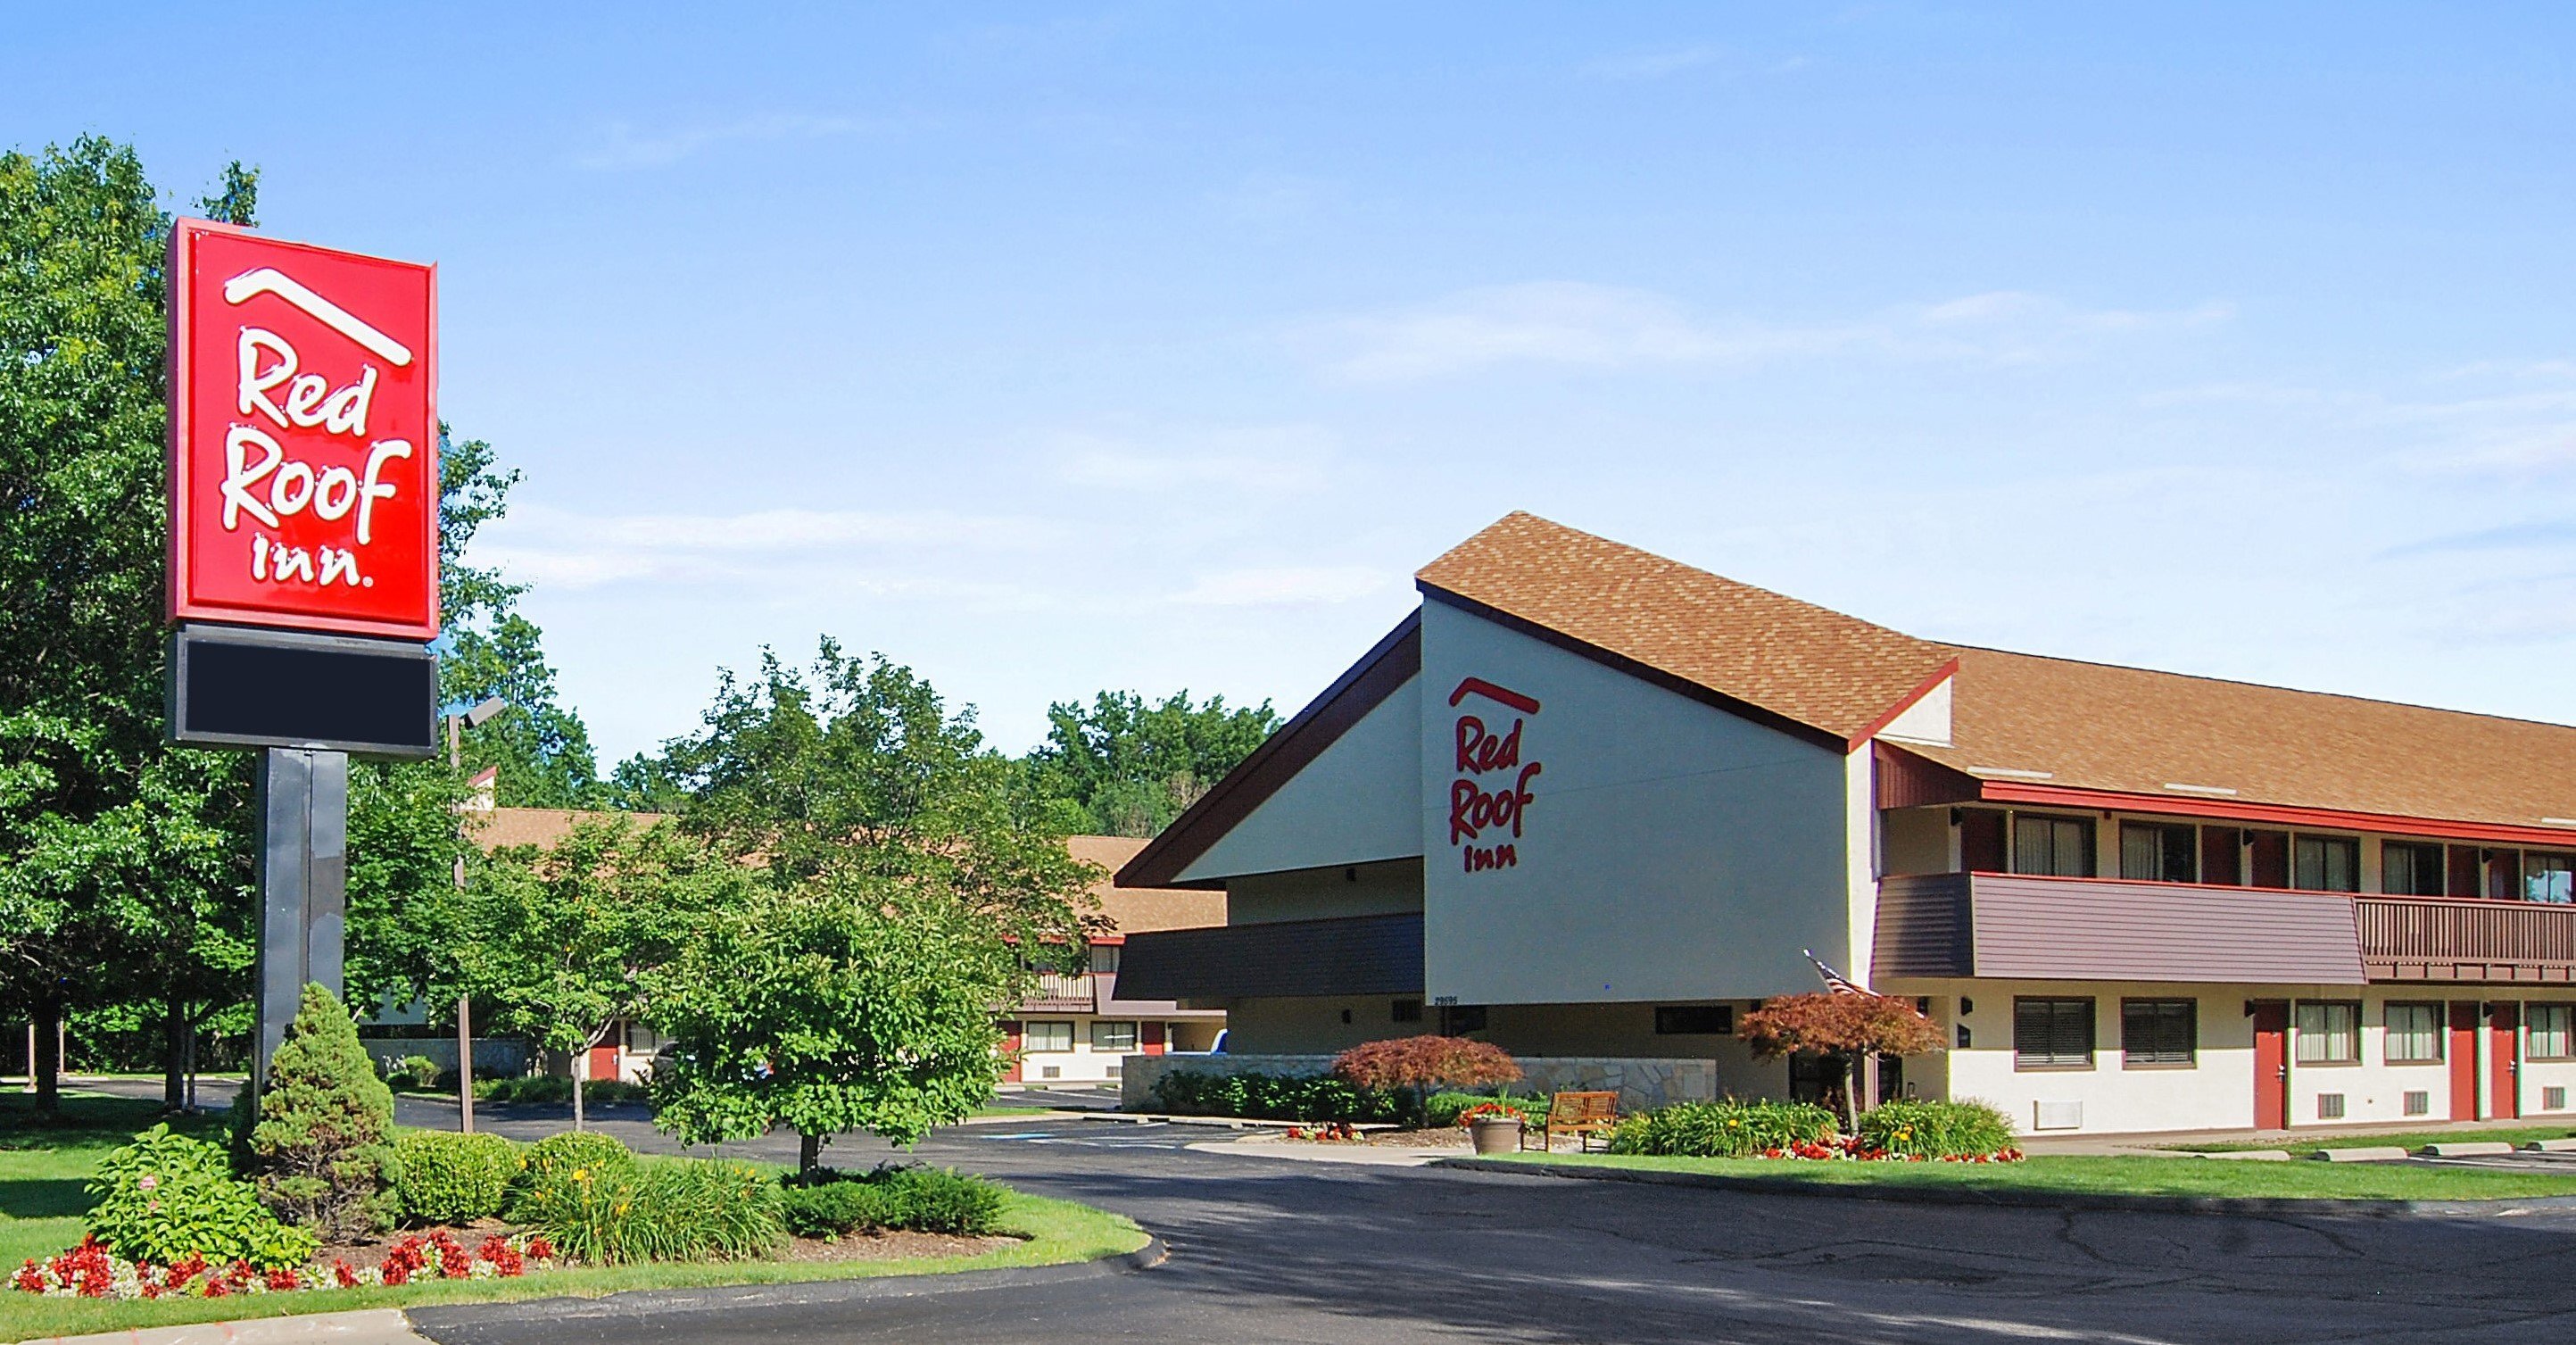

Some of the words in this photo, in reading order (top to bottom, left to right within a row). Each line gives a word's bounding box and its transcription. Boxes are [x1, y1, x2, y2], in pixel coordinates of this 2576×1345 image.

[237, 324, 378, 437] Red
[219, 421, 413, 546] Roof
[1455, 715, 1524, 776] Red
[1448, 761, 1542, 846] Roof
